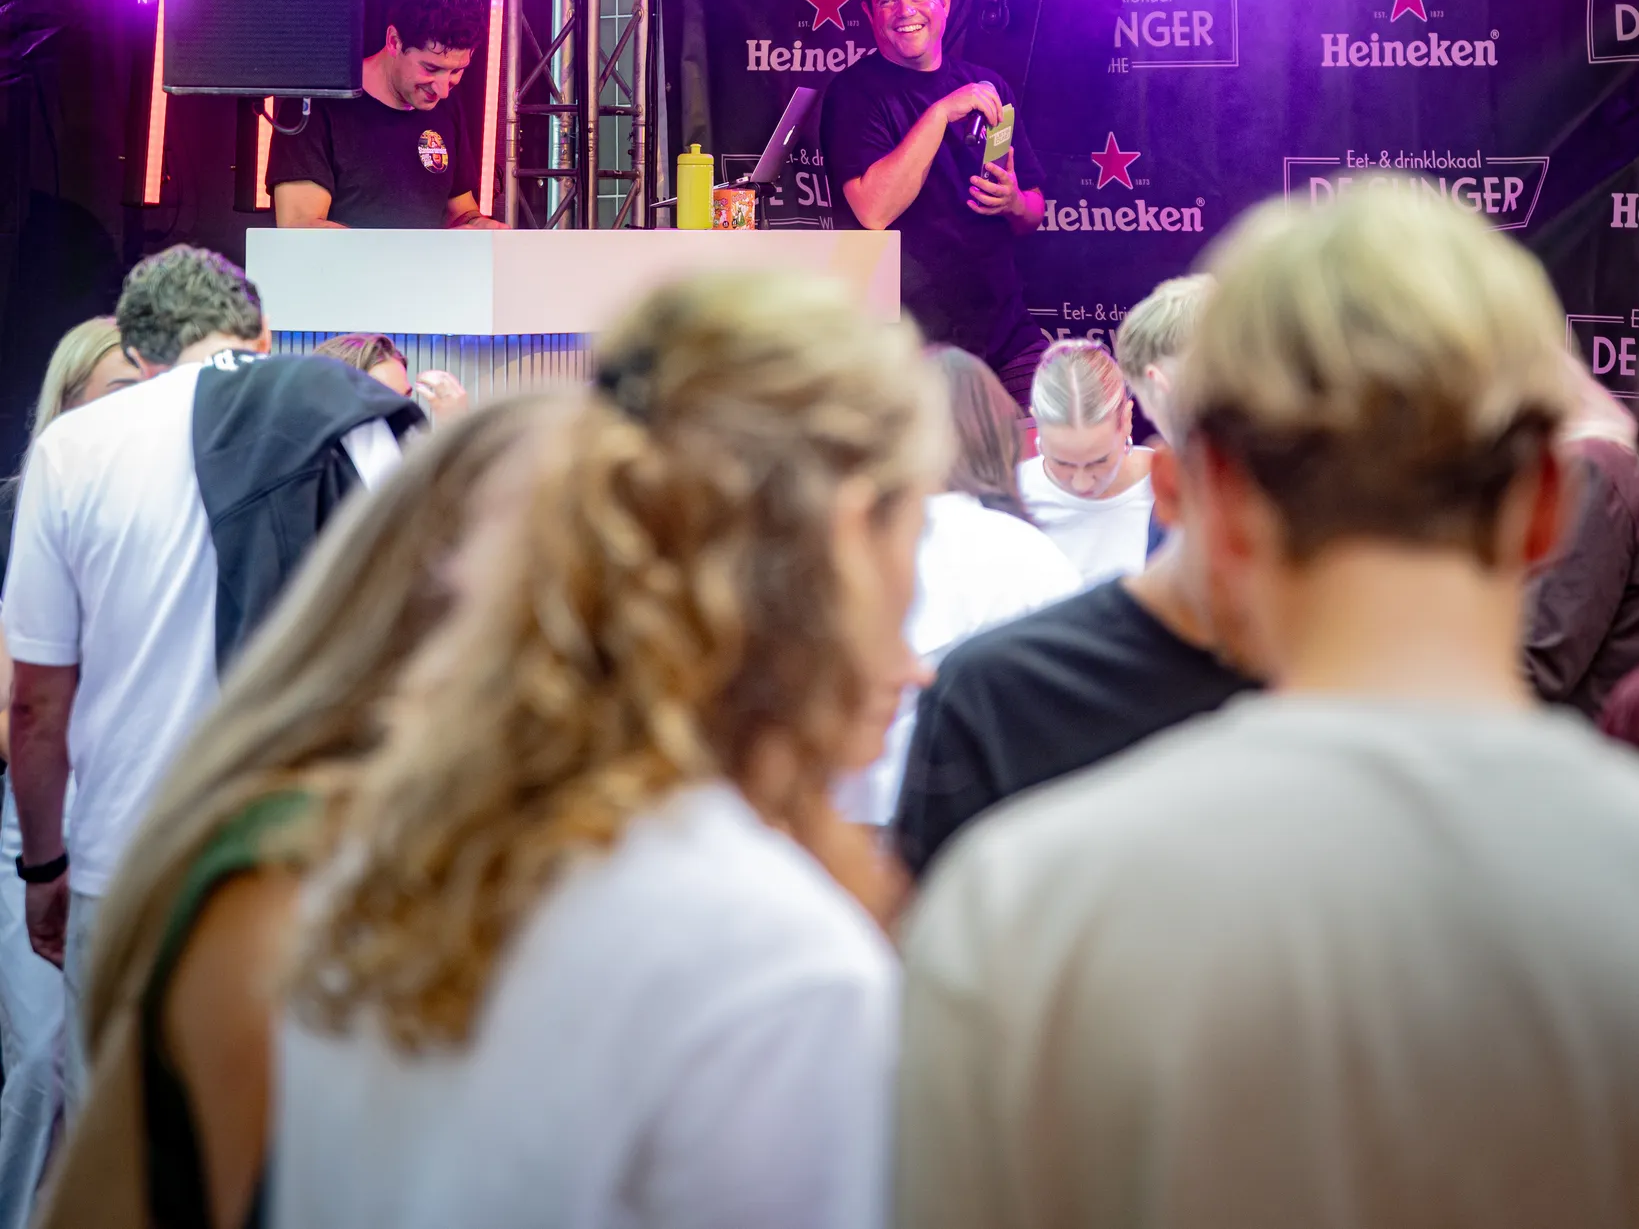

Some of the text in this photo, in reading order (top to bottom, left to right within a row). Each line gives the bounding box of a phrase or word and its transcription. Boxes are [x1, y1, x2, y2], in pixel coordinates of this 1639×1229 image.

[1430, 10, 1445, 18] 1873
[1114, 10, 1214, 48] NGER
[746, 39, 877, 72] Heinek
[800, 148, 811, 166] &
[1346, 149, 1482, 169] Eet- & drinklokaal
[1135, 178, 1150, 186] 1873
[1063, 302, 1093, 320] Eet-
[1095, 303, 1107, 321] &
[1593, 335, 1637, 376] DE
